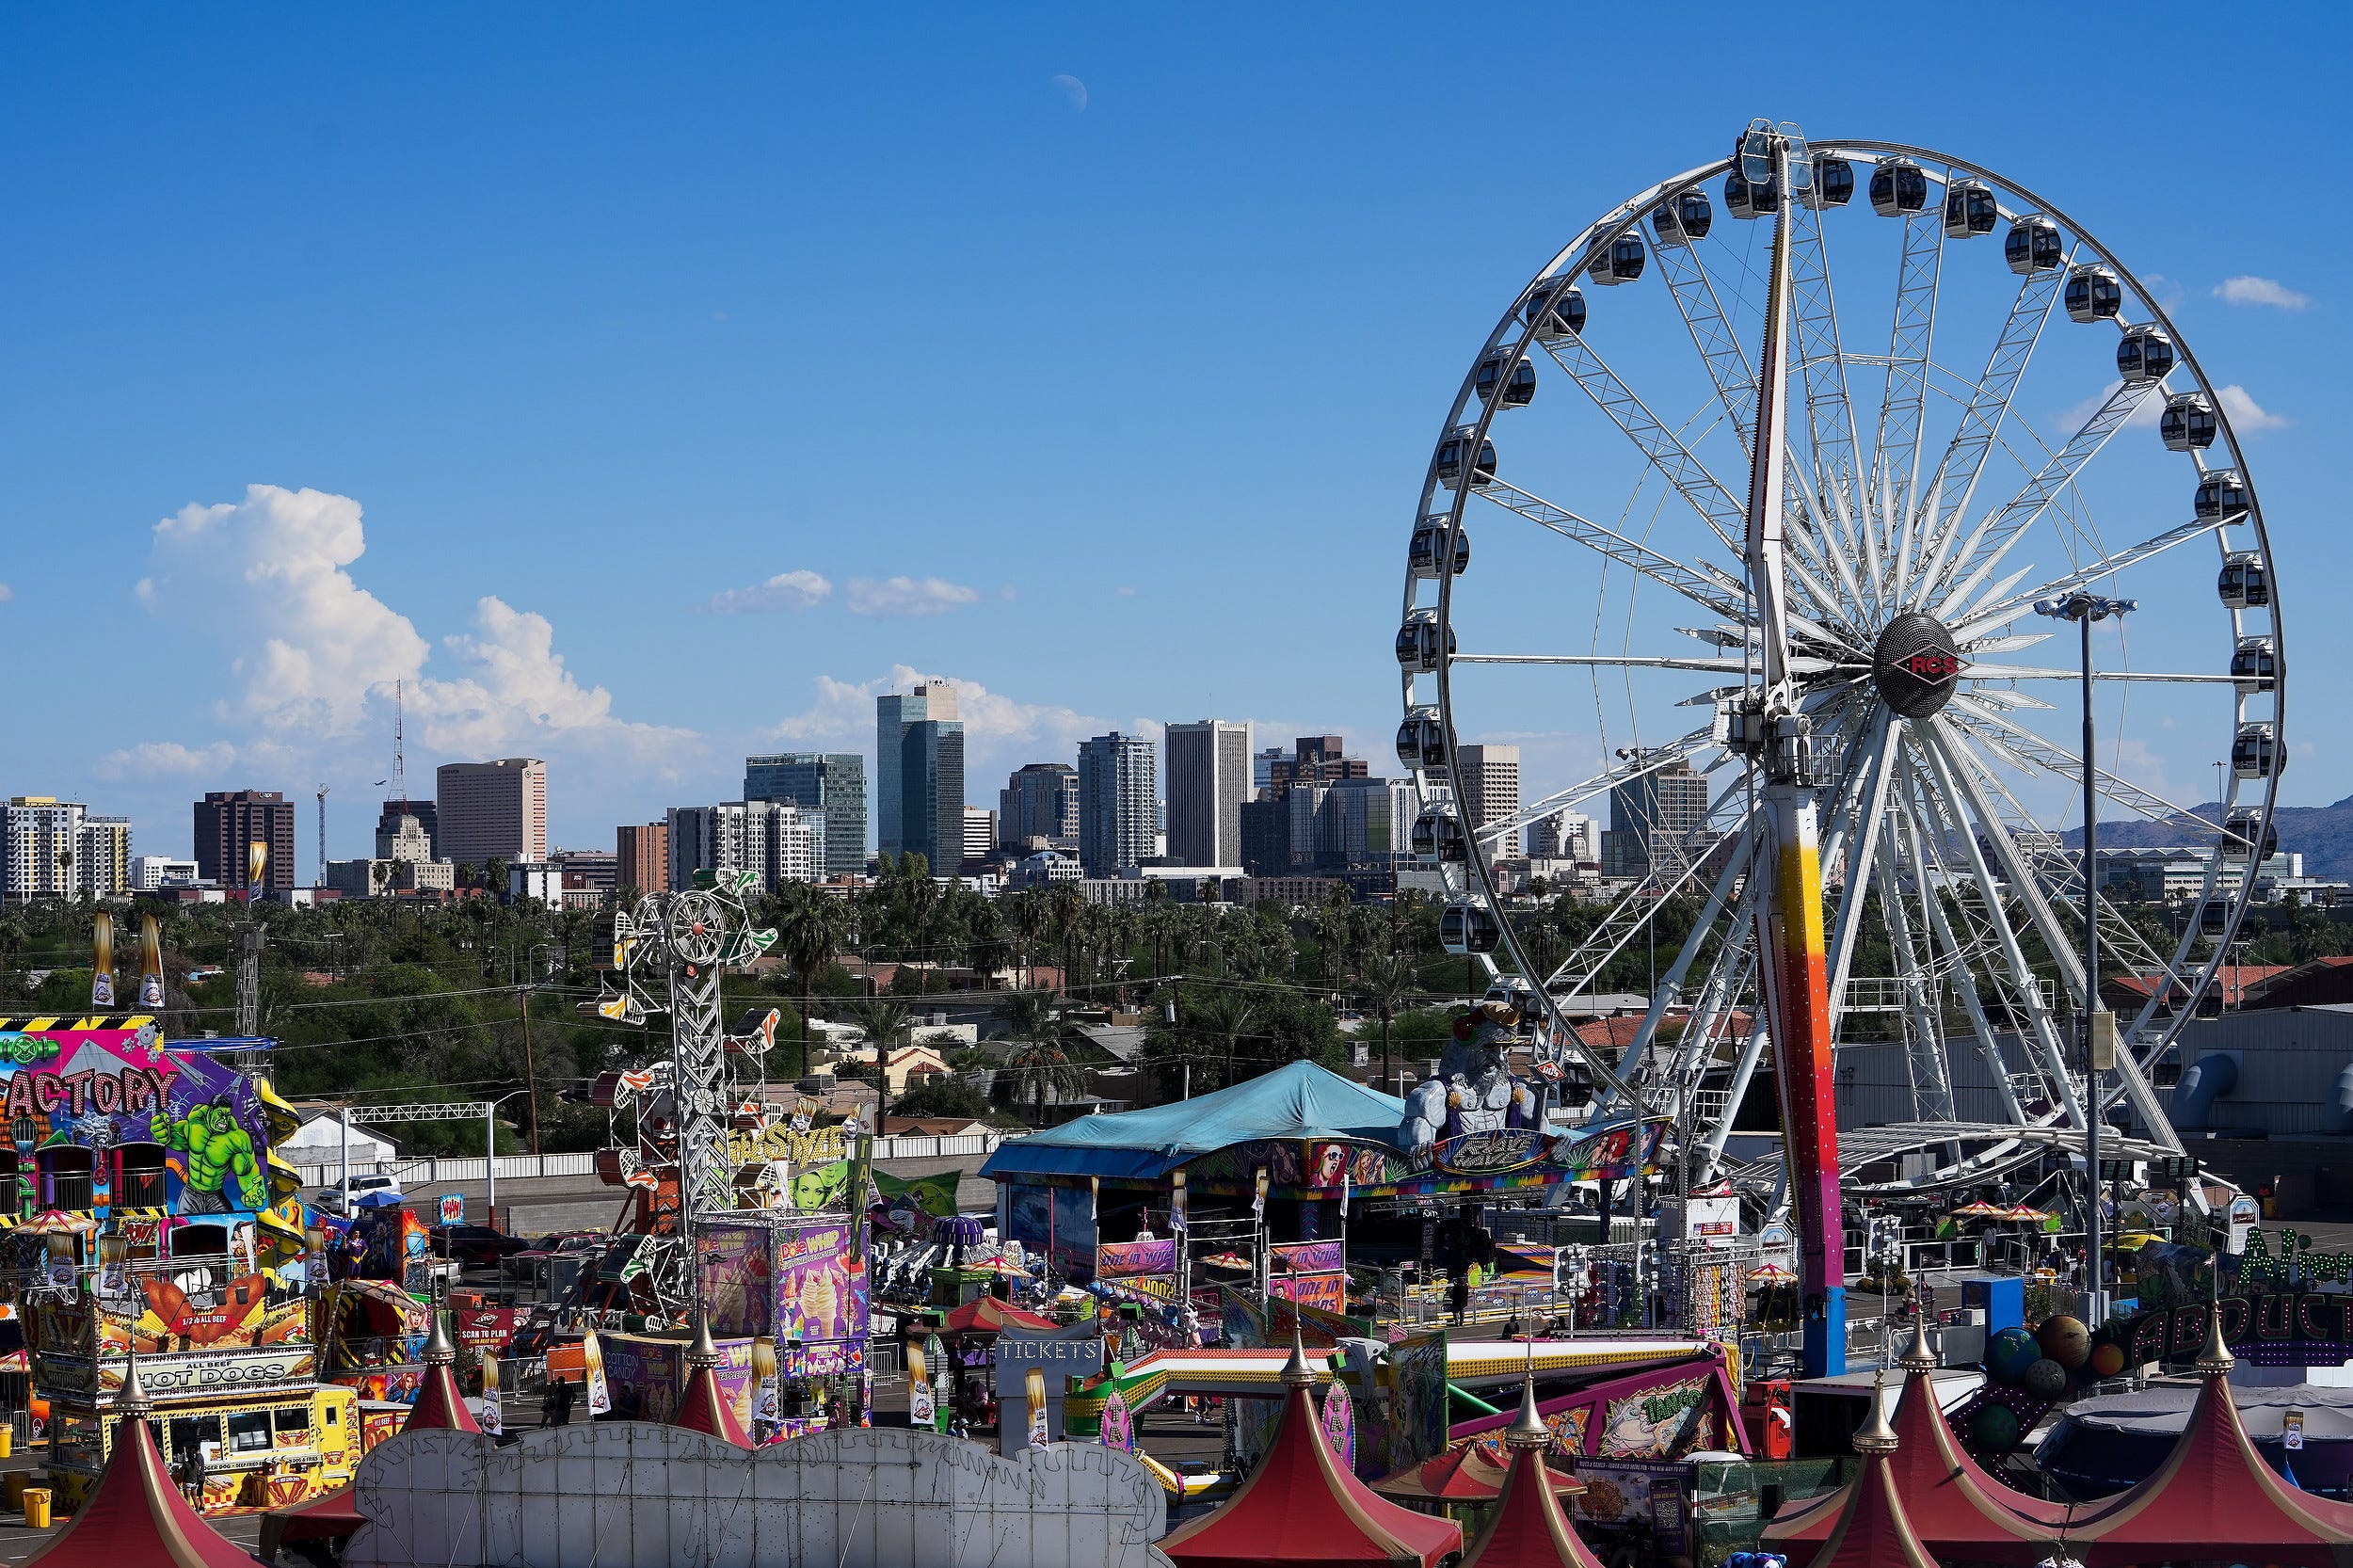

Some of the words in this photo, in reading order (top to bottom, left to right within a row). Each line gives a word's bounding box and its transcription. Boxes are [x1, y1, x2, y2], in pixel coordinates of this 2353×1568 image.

[1912, 656, 1960, 675] RCS
[0, 1066, 181, 1118] ACTORY
[780, 1240, 808, 1258] Dole
[807, 1229, 840, 1254] WHIP
[1128, 1253, 1141, 1264] IN
[1297, 1281, 1322, 1296] ONE
[1325, 1279, 1340, 1293] IN
[212, 1315, 227, 1323] BEEF
[480, 1314, 495, 1323] RCS
[462, 1330, 480, 1338] SCAN
[1000, 1341, 1096, 1359] TICKETS
[605, 1352, 639, 1366] COTTON
[48, 1370, 63, 1386] HOT
[63, 1372, 85, 1389] DOGS
[138, 1370, 193, 1388] HOT
[200, 1364, 285, 1384] DOGS
[607, 1366, 636, 1380] CANDY
[1641, 1386, 1704, 1424] TANGO
[381, 1416, 391, 1426] BEEF
[1330, 1394, 1346, 1460] TAN
